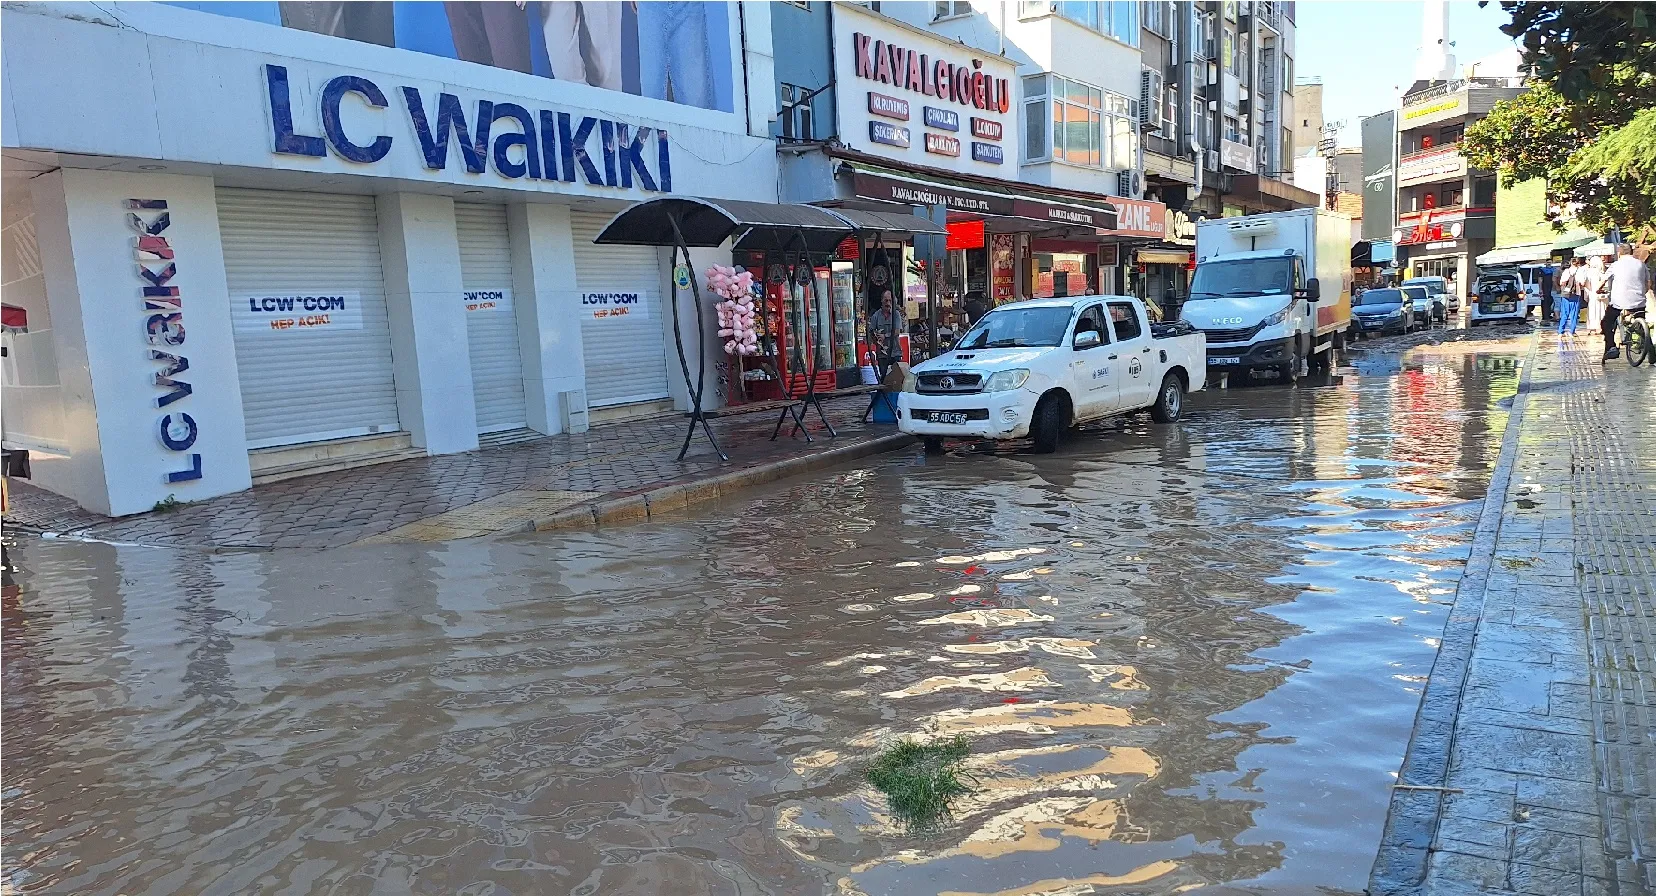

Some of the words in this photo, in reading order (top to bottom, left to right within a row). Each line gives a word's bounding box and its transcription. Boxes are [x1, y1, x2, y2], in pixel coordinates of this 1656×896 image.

[853, 32, 1009, 114] KAVALCIOĞLU
[263, 63, 393, 164] LC
[1117, 203, 1150, 231] ZANE
[270, 318, 295, 330] HEP
[298, 314, 331, 328] AÇIK!
[594, 310, 608, 319] HEP
[930, 412, 940, 422] 55
[159, 411, 203, 484] LC
